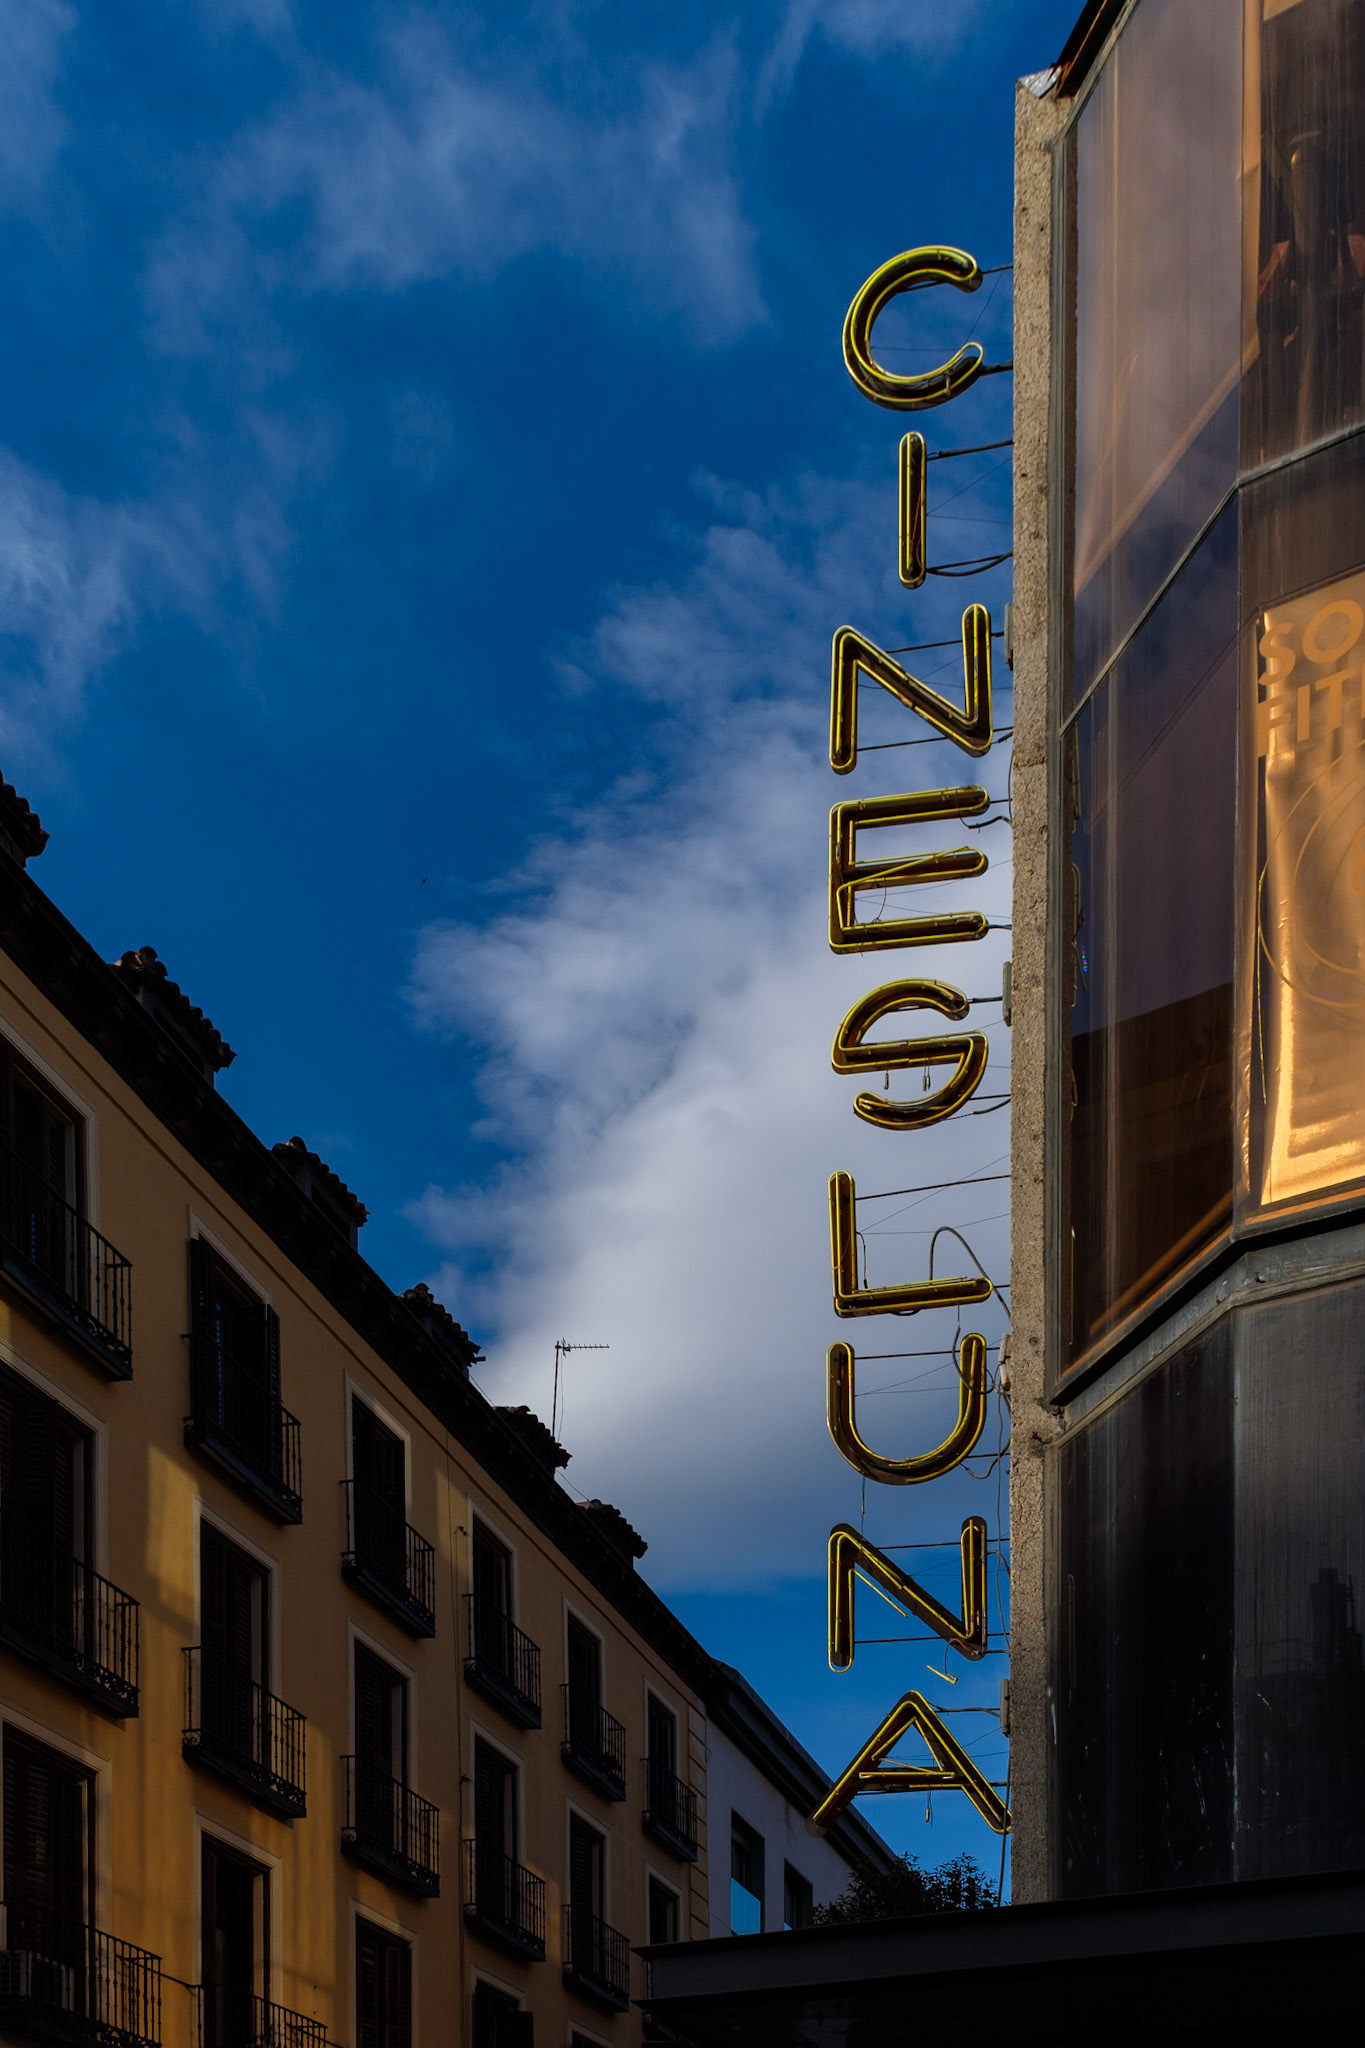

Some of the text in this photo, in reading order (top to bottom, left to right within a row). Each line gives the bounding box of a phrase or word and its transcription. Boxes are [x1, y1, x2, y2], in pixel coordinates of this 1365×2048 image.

[806, 244, 1012, 1837] CINES LUNA
[1258, 669, 1365, 758] FIT
